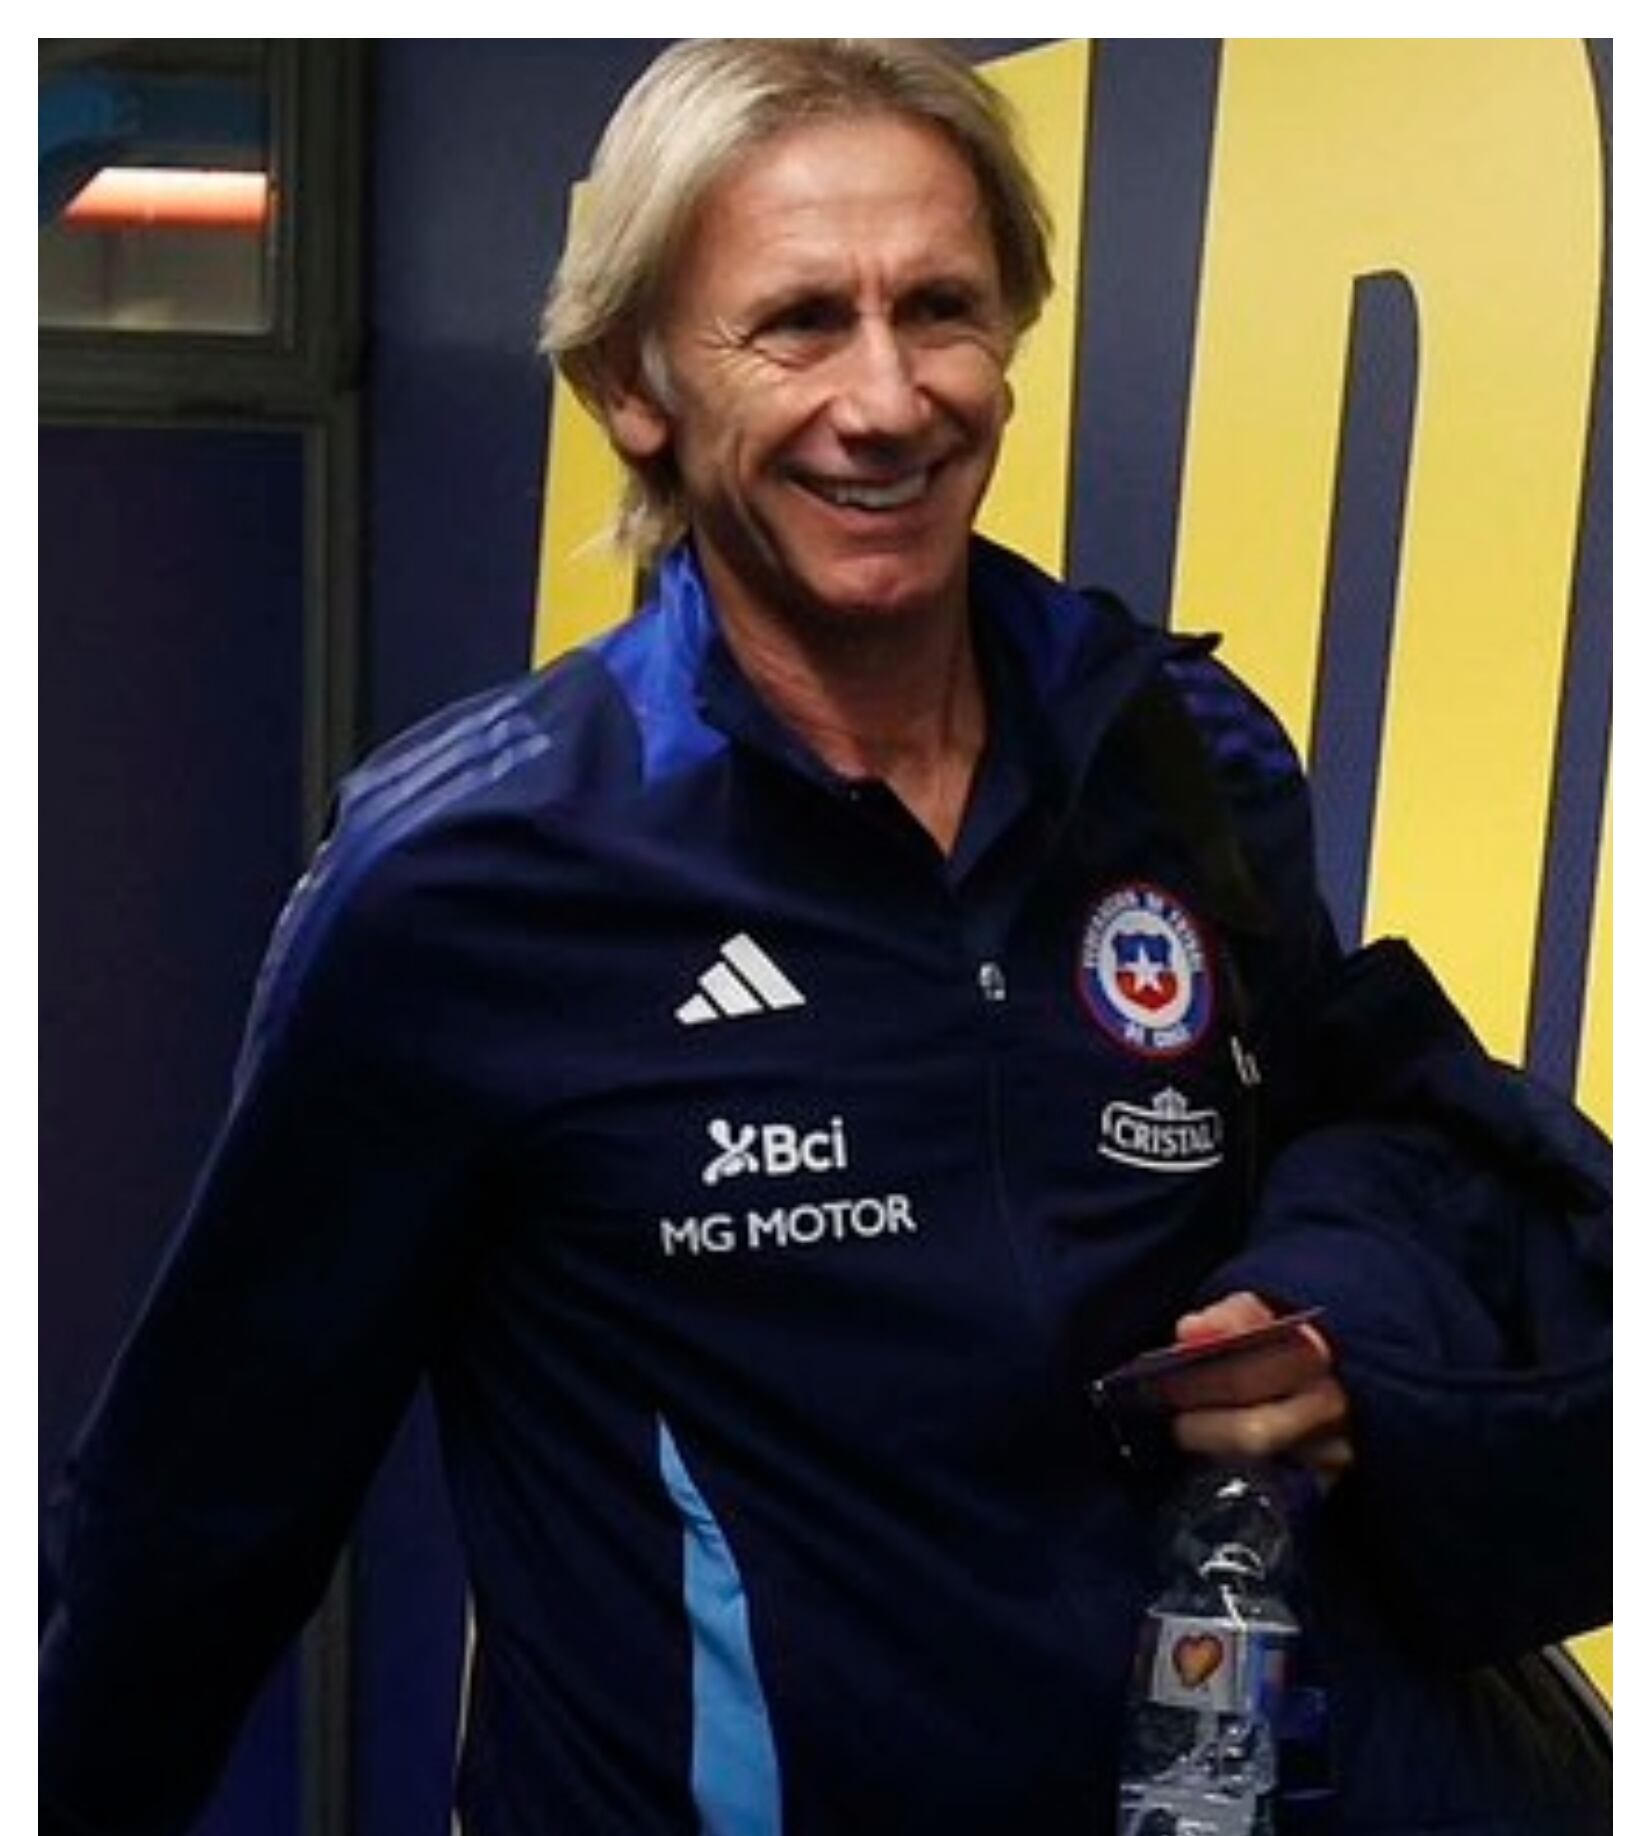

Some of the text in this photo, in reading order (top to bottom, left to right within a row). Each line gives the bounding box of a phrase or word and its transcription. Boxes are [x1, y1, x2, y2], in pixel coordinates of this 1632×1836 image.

[761, 1114, 848, 1175] Bci
[1112, 1113, 1216, 1156] CRISTAL
[659, 1193, 918, 1257] MG MOTOR
